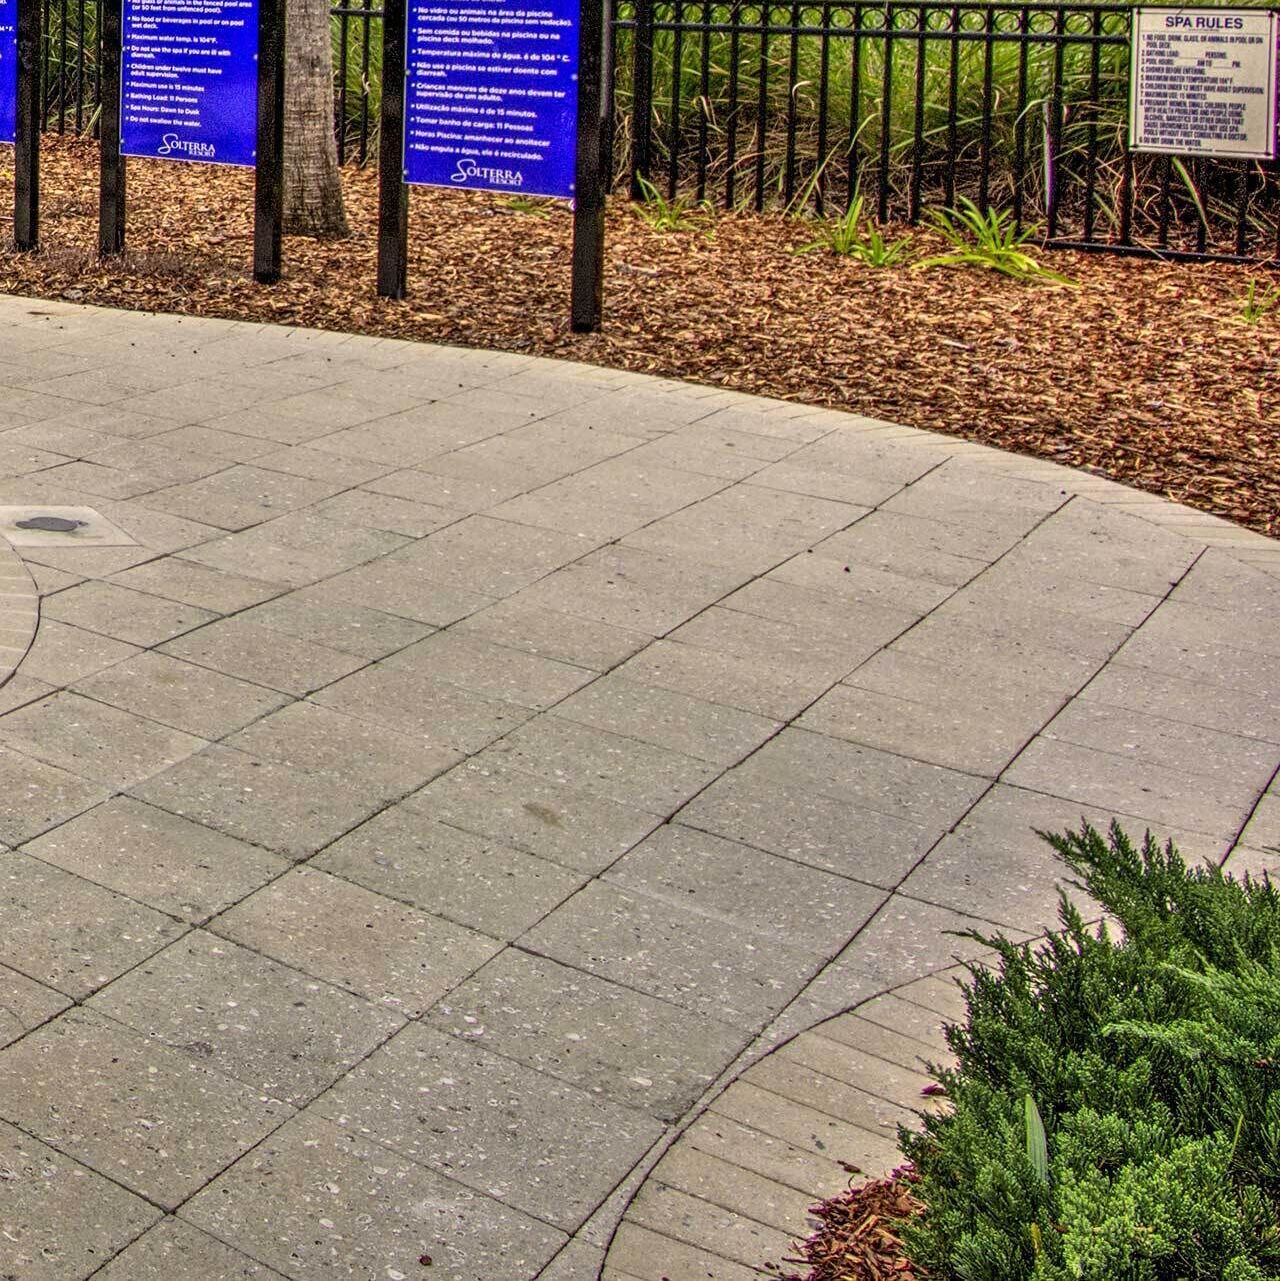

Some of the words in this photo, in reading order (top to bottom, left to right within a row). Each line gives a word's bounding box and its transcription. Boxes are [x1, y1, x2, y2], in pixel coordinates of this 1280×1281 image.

[1165, 16, 1192, 28] SPA
[1196, 17, 1244, 29] RULES
[158, 133, 215, 154] SOLTERRA
[451, 159, 522, 182] SOLTERRA
